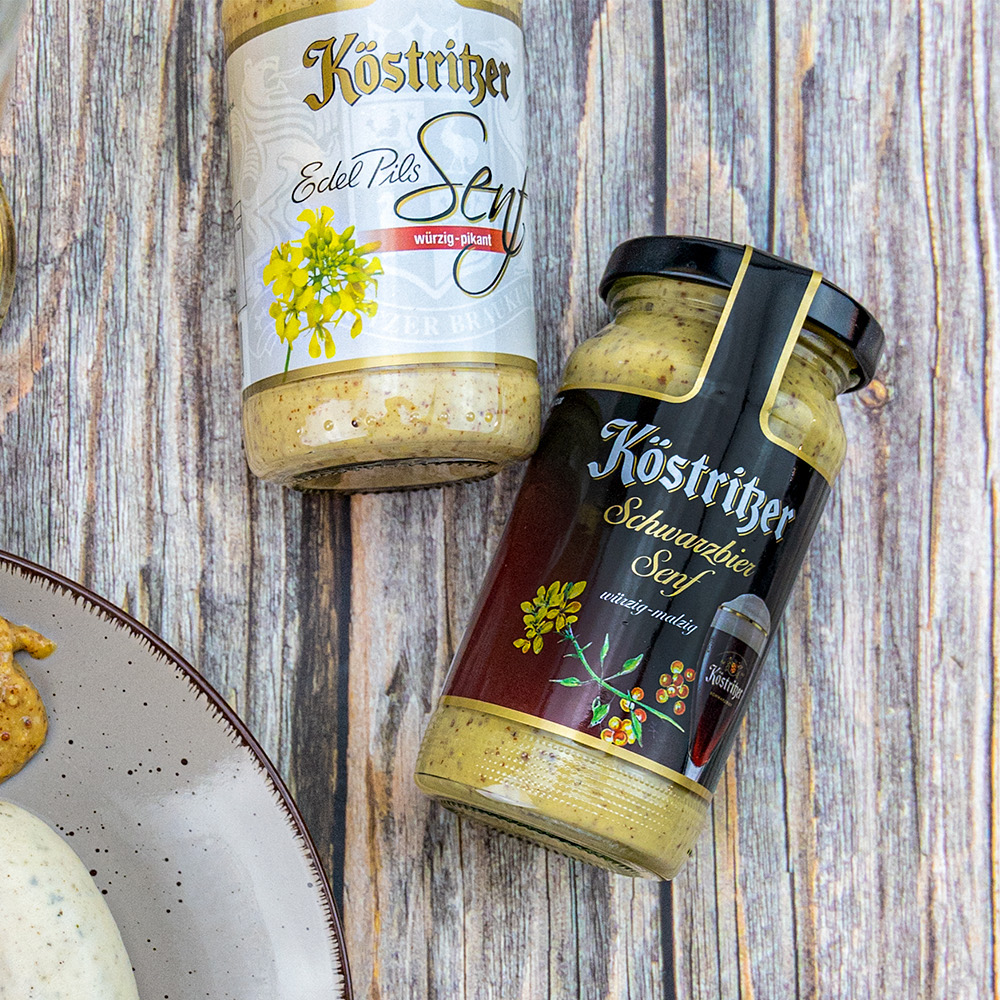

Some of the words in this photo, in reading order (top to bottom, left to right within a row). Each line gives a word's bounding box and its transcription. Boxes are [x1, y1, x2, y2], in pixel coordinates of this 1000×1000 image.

[302, 33, 511, 111] Köstritzer
[291, 160, 365, 204] Edel
[352, 147, 421, 189] Pils
[394, 111, 529, 298] Senf
[414, 231, 493, 247] würzig-pikant
[587, 418, 796, 543] Köstritzer
[603, 496, 757, 577] Schwarzbier
[631, 549, 716, 598] Senf
[599, 591, 698, 636] würzig-malzig
